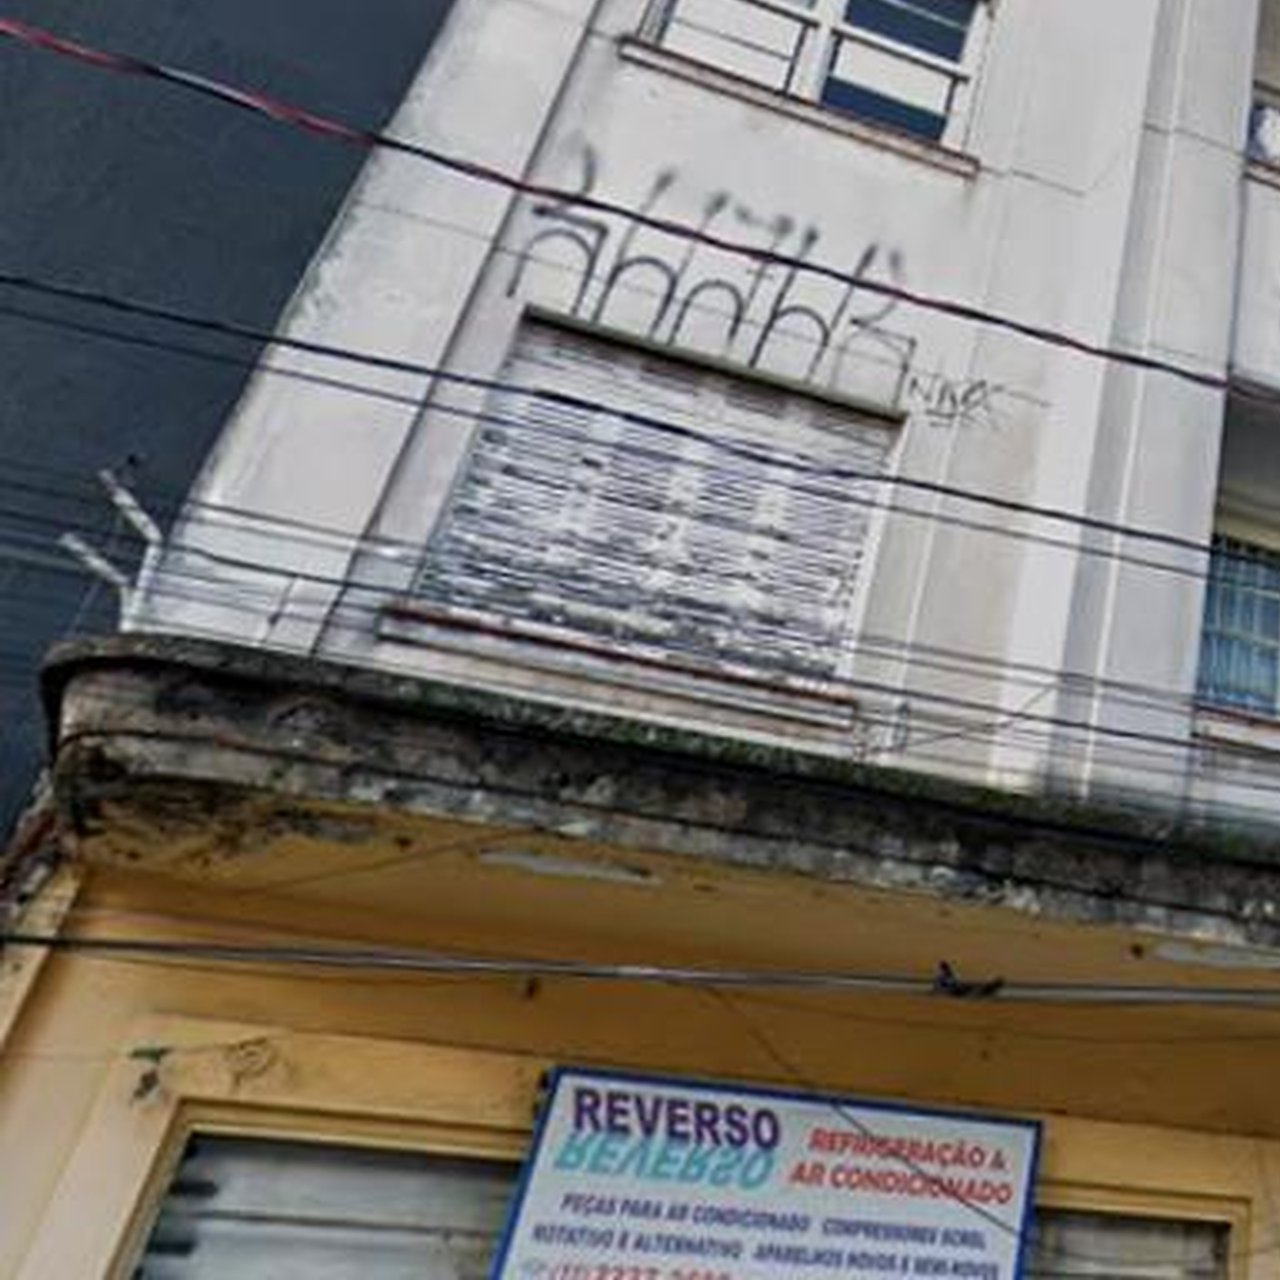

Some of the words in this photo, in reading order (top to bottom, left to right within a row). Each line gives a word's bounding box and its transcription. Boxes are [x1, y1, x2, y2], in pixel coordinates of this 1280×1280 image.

[574, 1087, 780, 1150] REVERSO
[809, 1127, 985, 1168] REFRIGERAÇÃO
[790, 1161, 826, 1186] AR
[831, 1164, 1014, 1205] CONDICIONADO
[560, 1192, 616, 1217] PEÇAS
[620, 1198, 662, 1218] PARA
[667, 1202, 689, 1221] AR
[692, 1204, 811, 1232] CONDICIONADO
[532, 1223, 614, 1250] ROTATIVO
[618, 1229, 630, 1250] E
[633, 1232, 743, 1259] ALTERNATIVO
